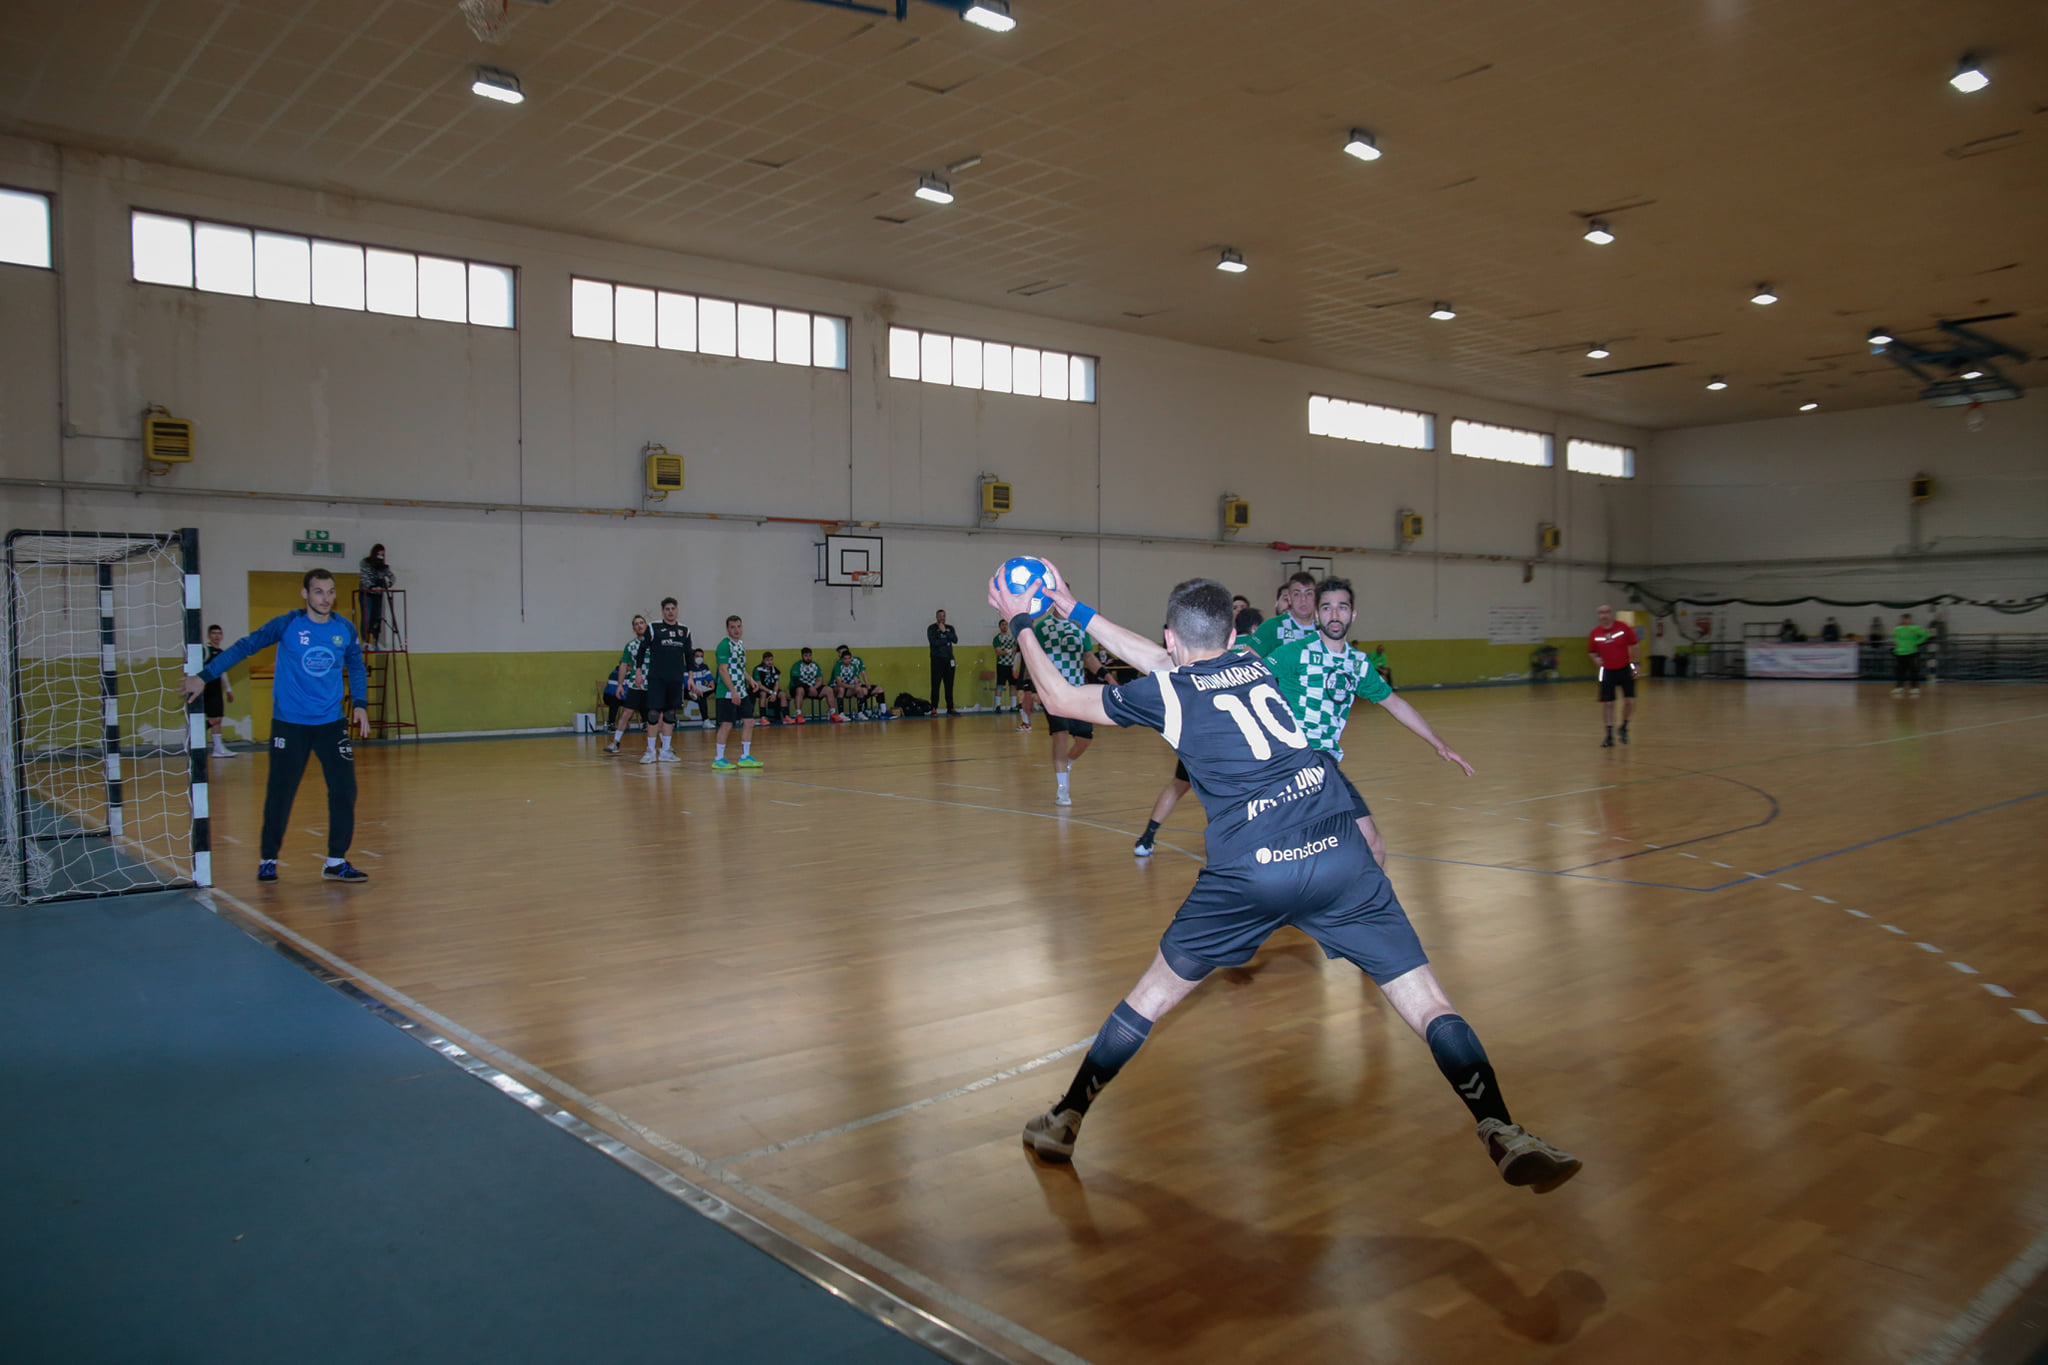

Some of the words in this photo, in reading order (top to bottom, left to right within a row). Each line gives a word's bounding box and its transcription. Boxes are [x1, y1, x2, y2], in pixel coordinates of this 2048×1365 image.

[300, 636, 310, 645] 12
[1313, 653, 1321, 664] 17
[1213, 683, 1309, 760] 10
[273, 736, 286, 749] 16
